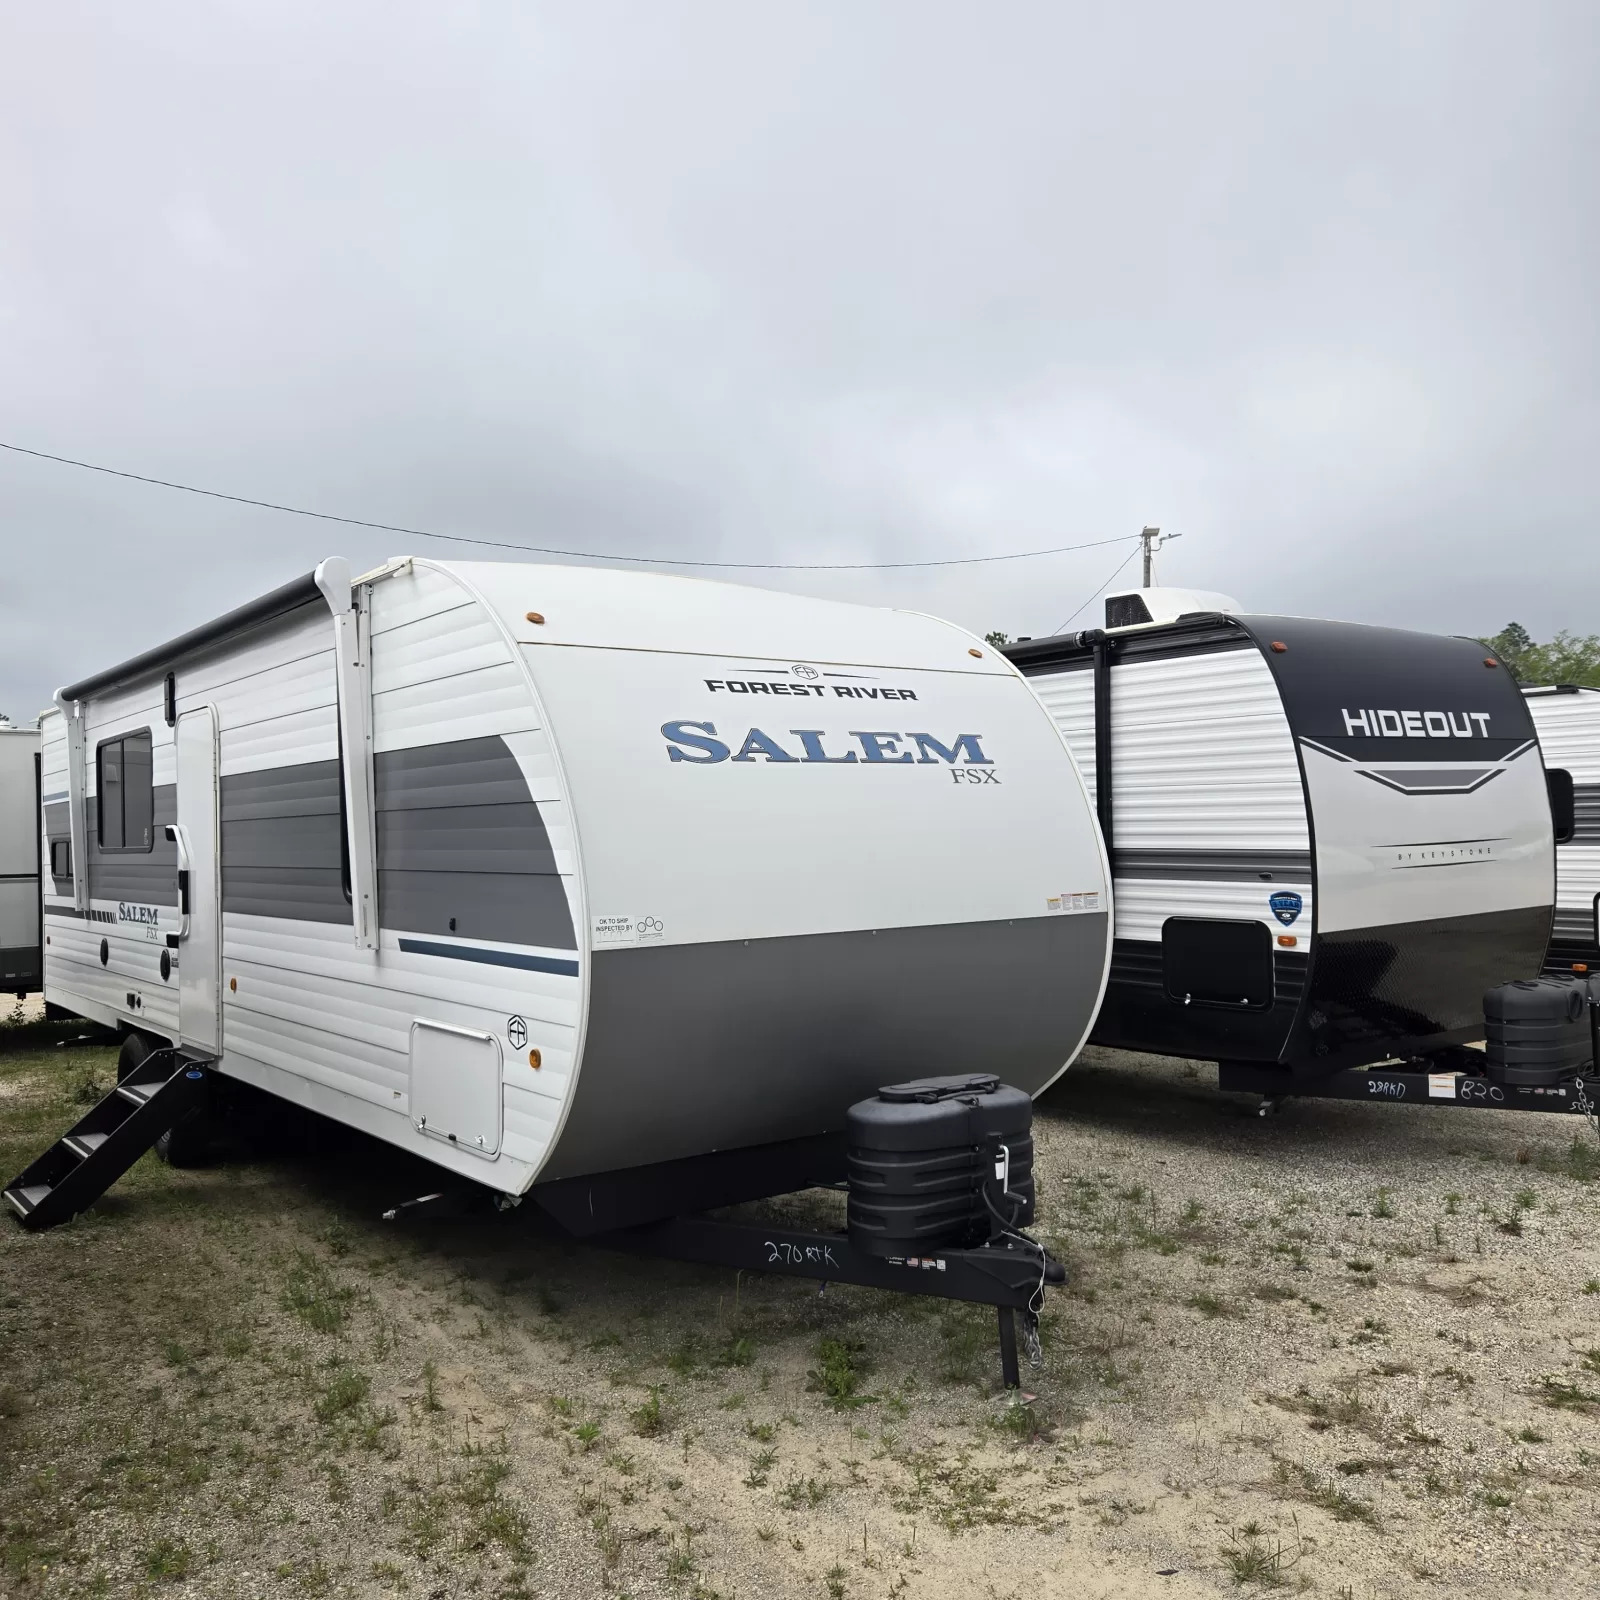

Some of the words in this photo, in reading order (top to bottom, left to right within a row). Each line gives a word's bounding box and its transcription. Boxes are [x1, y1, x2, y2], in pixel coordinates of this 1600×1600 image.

[703, 679, 825, 697] FOREST
[830, 686, 919, 701] RIVER
[1341, 708, 1491, 738] HIDEOUT
[660, 719, 995, 764] SALEM
[949, 768, 1002, 784] FSX
[1398, 852, 1411, 860] BY
[1421, 847, 1491, 859] KEYSTONE
[119, 901, 159, 925] SALEM
[146, 926, 159, 940] FSX
